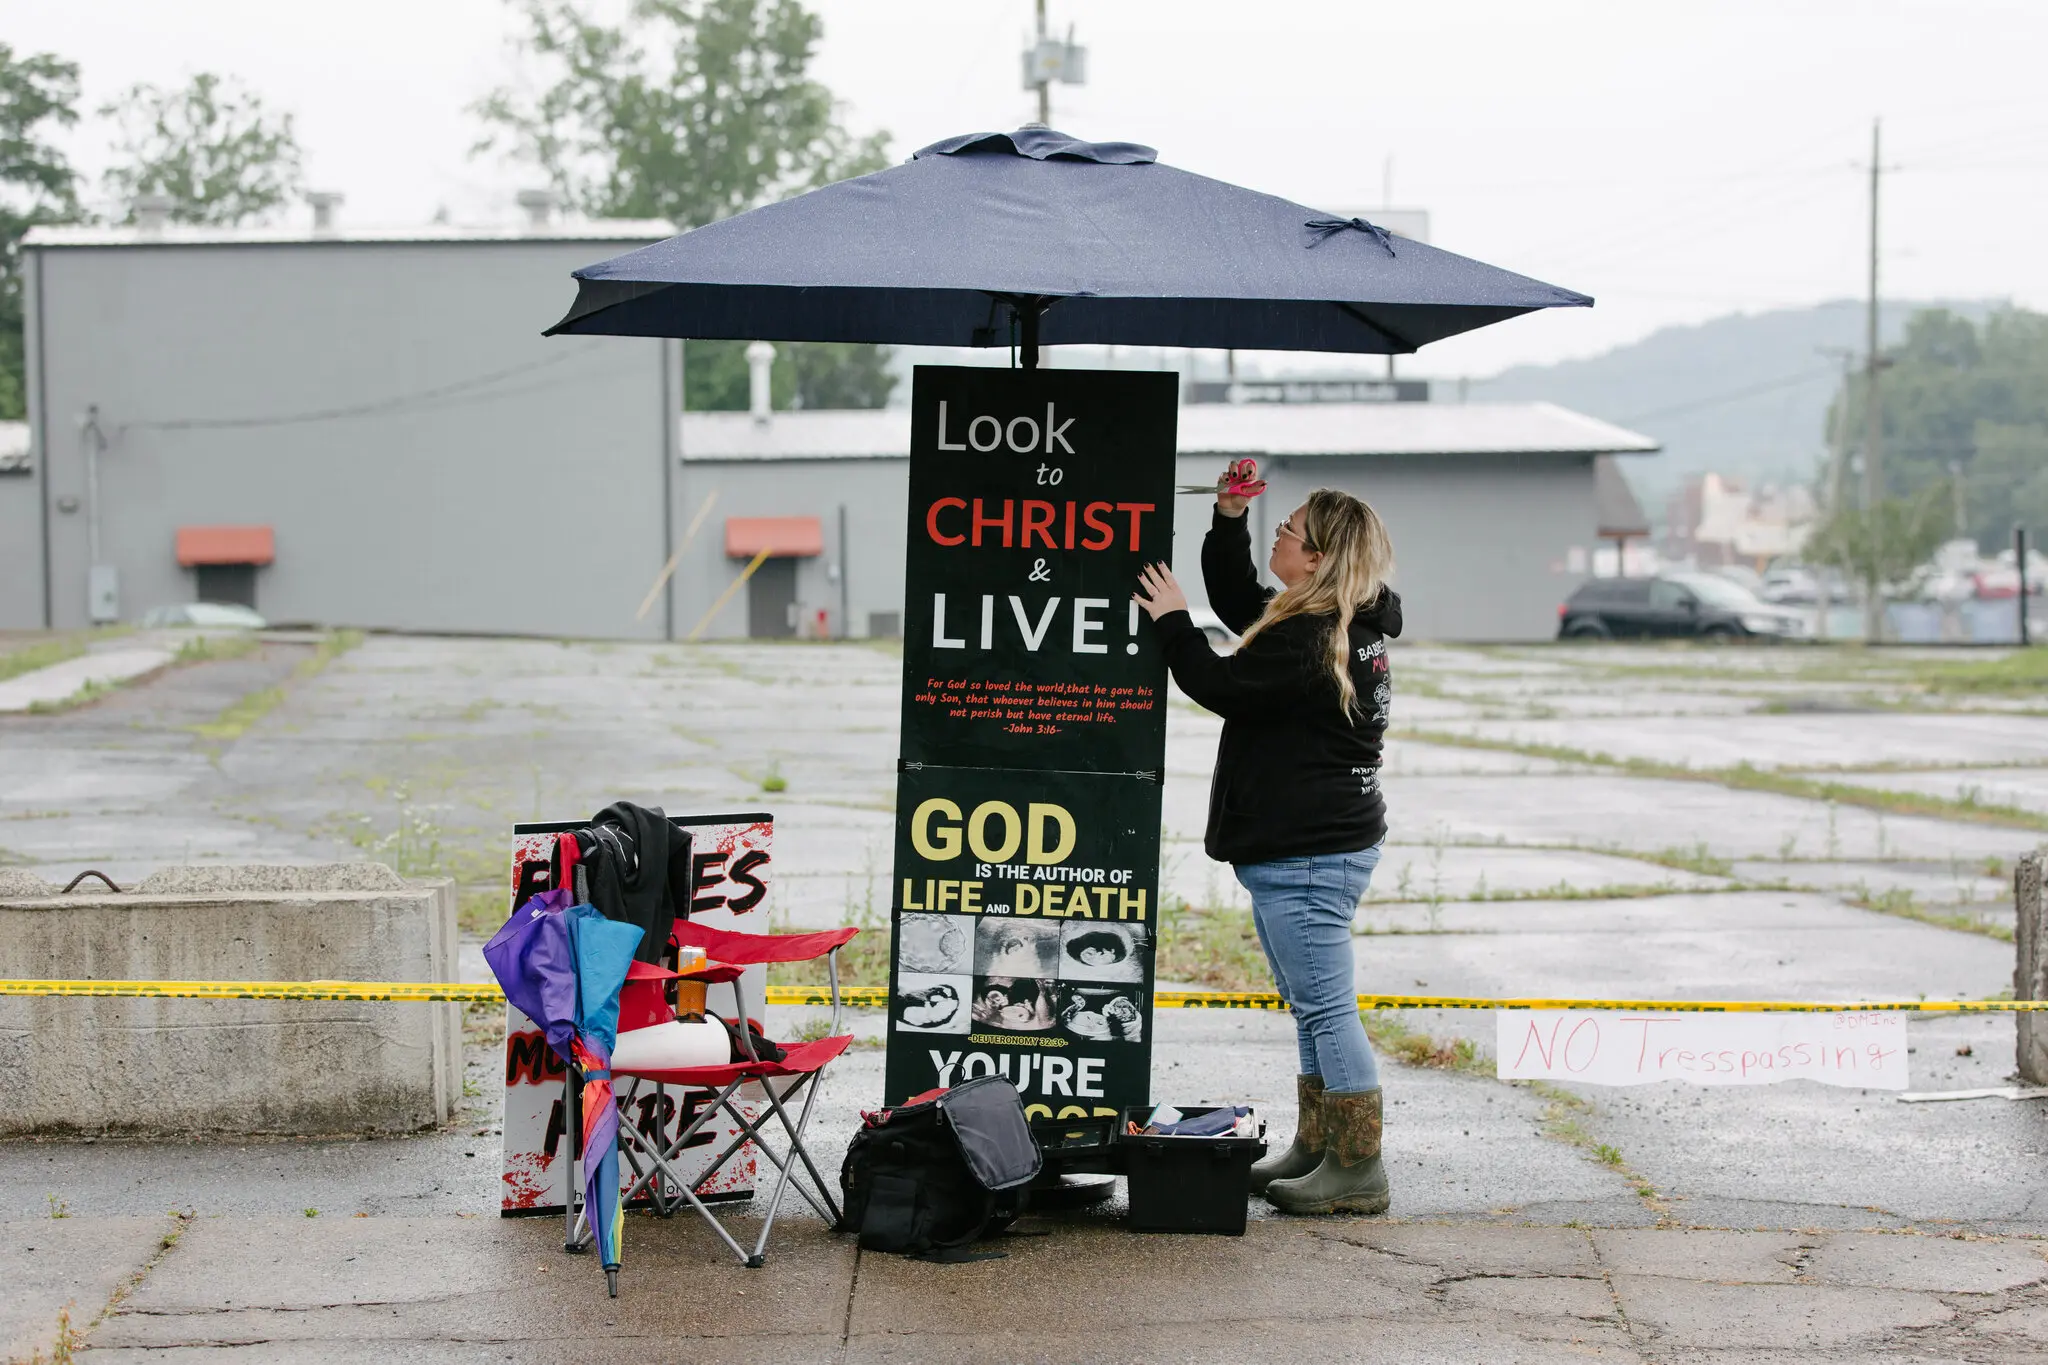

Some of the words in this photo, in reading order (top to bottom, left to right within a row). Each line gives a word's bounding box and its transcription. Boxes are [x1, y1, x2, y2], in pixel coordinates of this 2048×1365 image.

[938, 401, 1075, 453] Look
[1037, 463, 1062, 485] to
[927, 498, 1155, 551] CHRIST
[1029, 558, 1050, 581] &
[932, 593, 1139, 656] LIVE!
[915, 692, 937, 705] only
[940, 693, 961, 706] Son,
[965, 693, 989, 704] that
[993, 694, 1034, 706] whoever
[1037, 696, 1078, 708] believes
[1081, 698, 1093, 708] in
[1095, 698, 1116, 709] him
[1119, 699, 1153, 710] should
[927, 678, 944, 689] For
[947, 679, 967, 689] God
[970, 682, 981, 690] so
[985, 680, 1012, 691] loved
[1015, 681, 1033, 692] the
[1093, 684, 1107, 695] he
[1110, 687, 1134, 698] gave
[1137, 686, 1153, 696] his
[949, 708, 967, 717] not
[970, 708, 1003, 720] perish
[1006, 708, 1025, 720] but
[1027, 709, 1052, 721] have
[1055, 711, 1093, 722] eternal
[1096, 712, 1117, 723] life.
[912, 798, 1076, 865] GOD
[975, 863, 992, 878] IS
[996, 864, 1029, 879] THE
[1033, 866, 1105, 883] AUTHOR
[1109, 869, 1133, 885] OF
[903, 879, 984, 914] LIFE
[985, 903, 1011, 914] AND
[1015, 883, 1147, 921] DEATH
[1513, 1016, 1600, 1073] NO
[1620, 1018, 1897, 1078] Tresspassing
